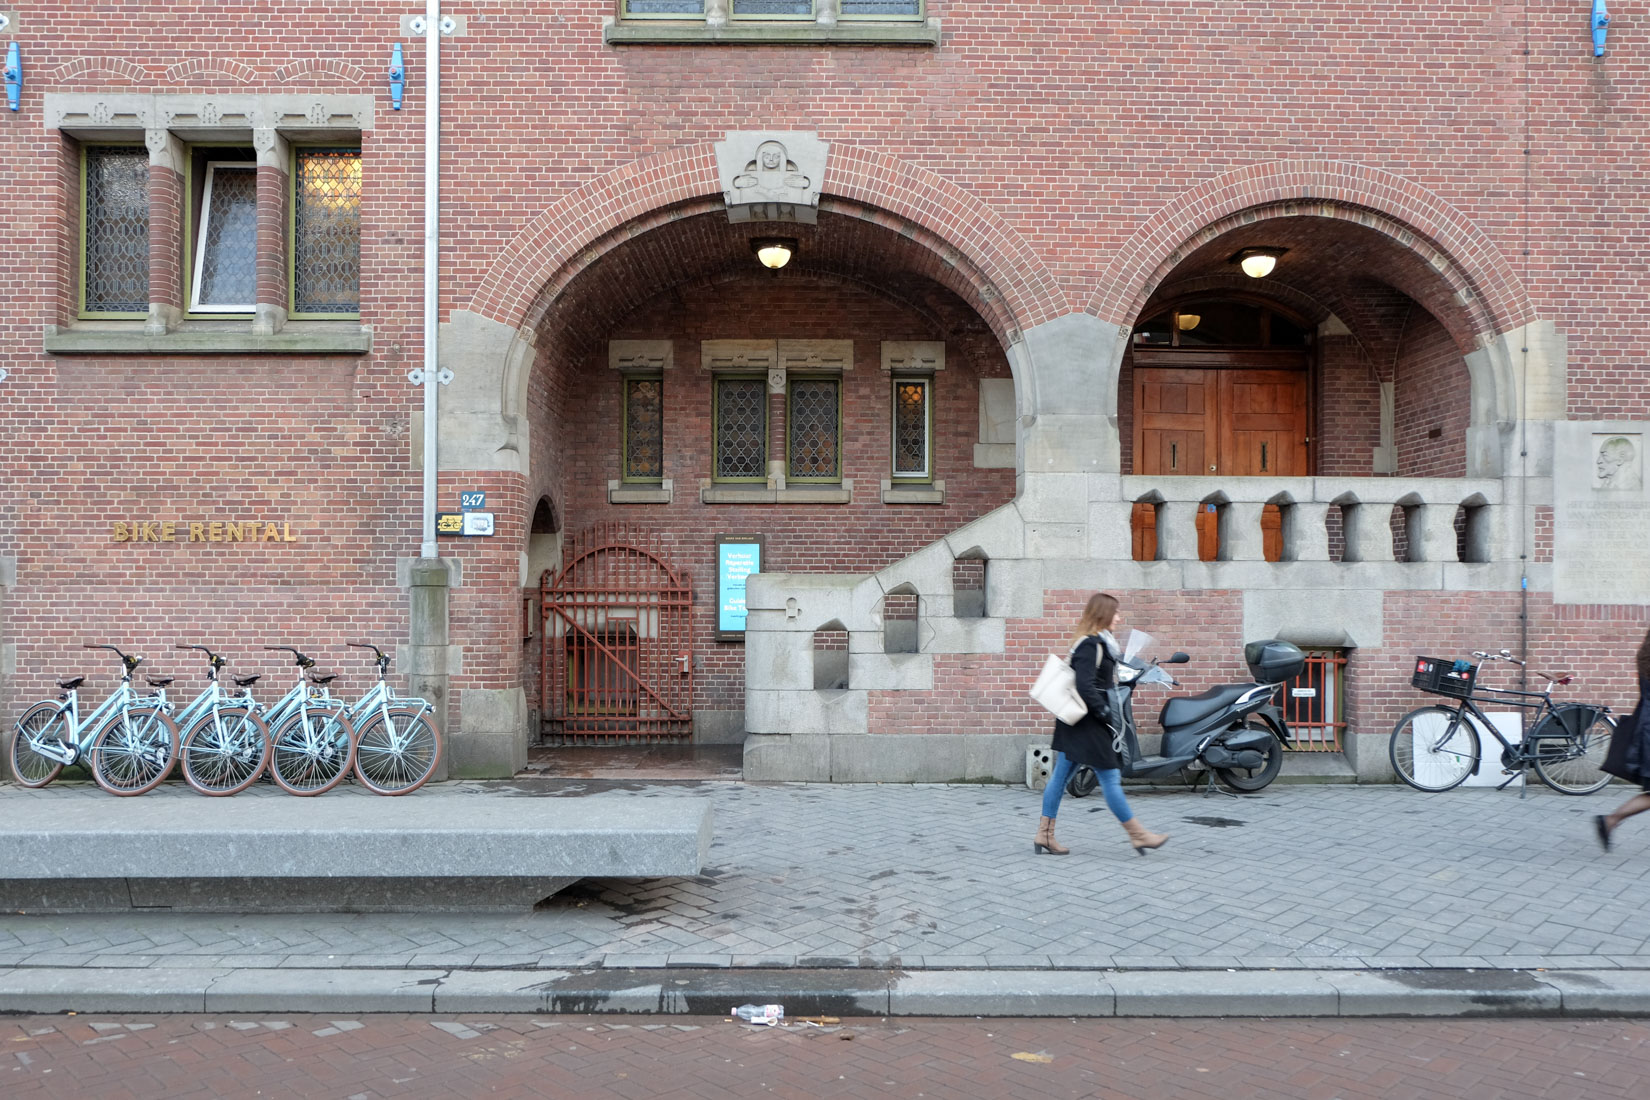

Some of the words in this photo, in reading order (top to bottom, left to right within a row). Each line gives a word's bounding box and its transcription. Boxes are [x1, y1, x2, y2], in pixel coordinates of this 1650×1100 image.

[462, 494, 485, 506] 247
[113, 521, 176, 543] BIKE
[189, 521, 297, 543] RENTAL
